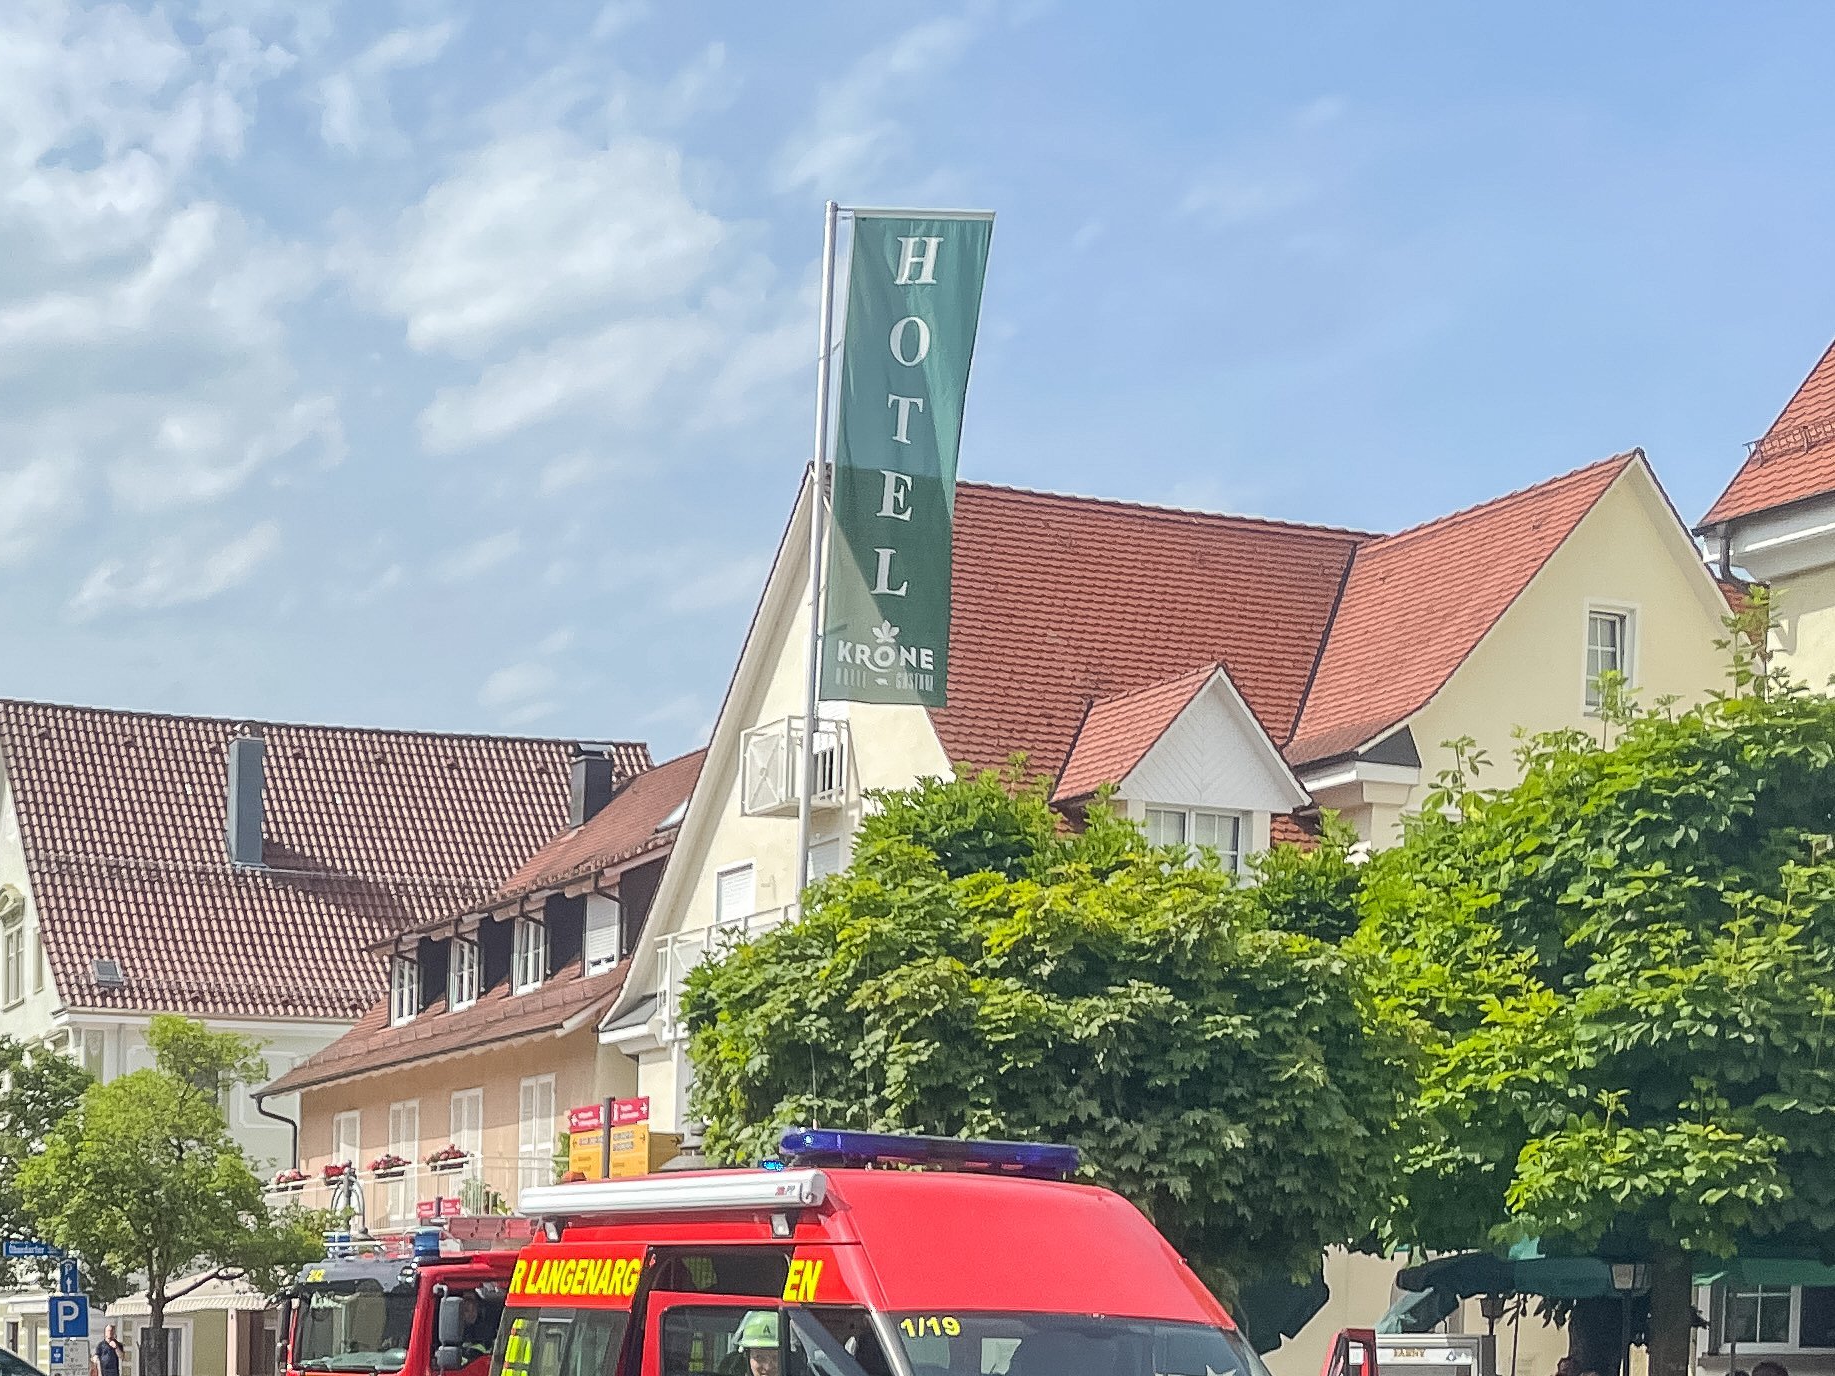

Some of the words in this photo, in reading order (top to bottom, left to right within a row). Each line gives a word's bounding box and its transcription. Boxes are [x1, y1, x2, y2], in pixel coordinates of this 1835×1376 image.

[870, 236, 944, 598] HOTEL
[837, 640, 934, 673] KRONE
[57, 1300, 79, 1334] P
[900, 1316, 961, 1338] 1/19
